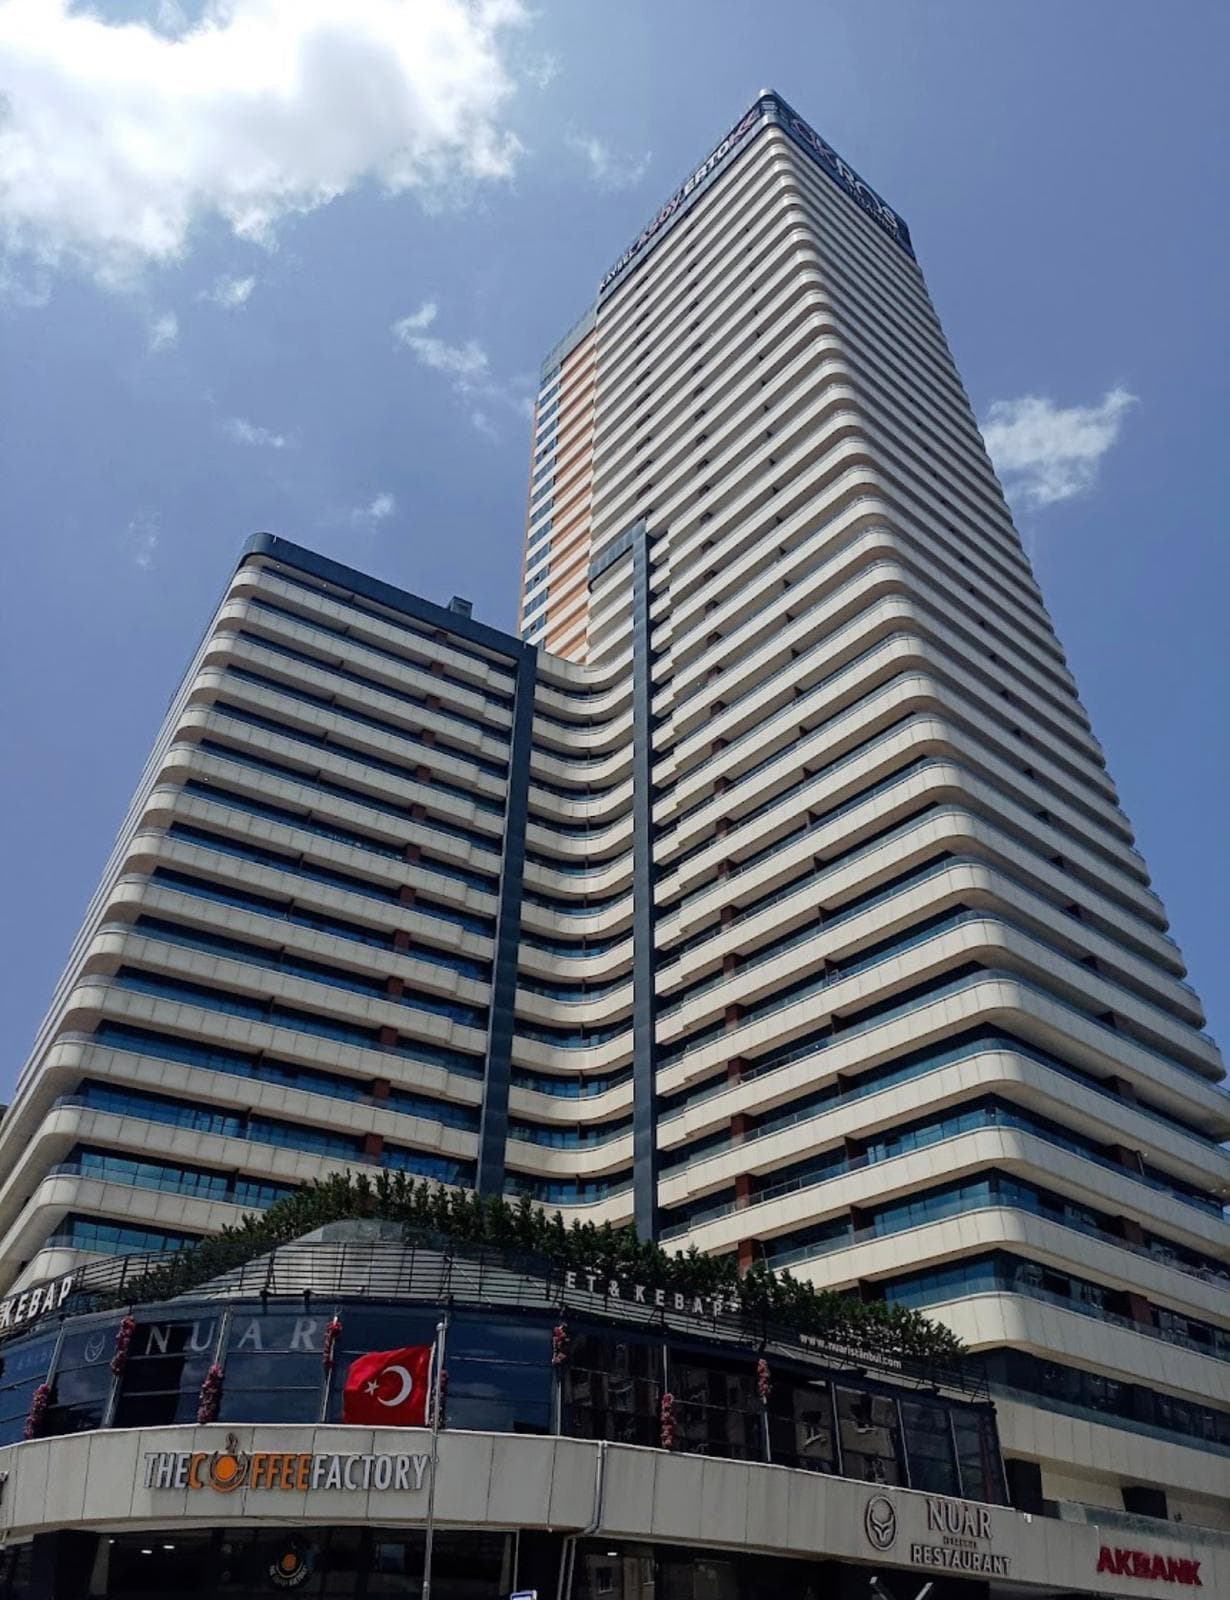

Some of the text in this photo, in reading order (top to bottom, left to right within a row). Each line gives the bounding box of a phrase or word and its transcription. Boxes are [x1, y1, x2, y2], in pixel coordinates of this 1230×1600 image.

[0, 1276, 74, 1329] KEBAP
[565, 1270, 722, 1316] ET & KEBAP
[146, 1316, 318, 1355] NUAR
[926, 1497, 993, 1539] NUAR
[911, 1543, 1010, 1576] RESTAURANT
[1097, 1545, 1203, 1586] AKBANK
